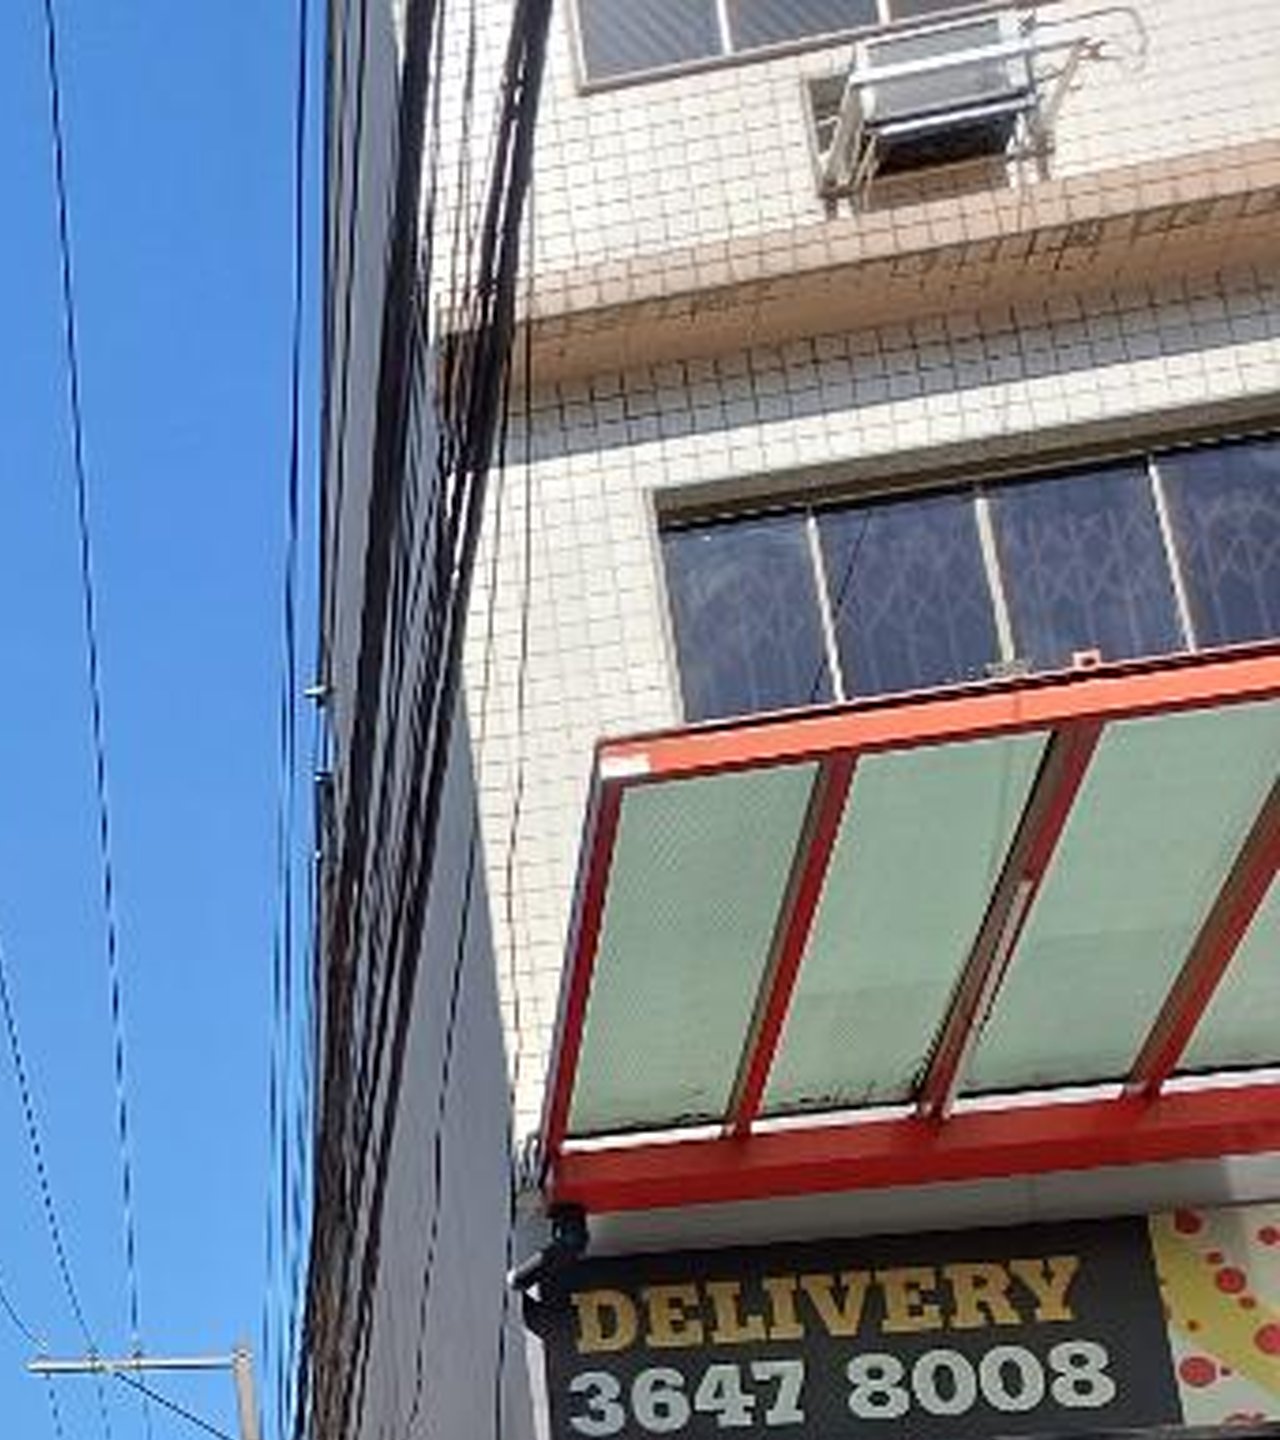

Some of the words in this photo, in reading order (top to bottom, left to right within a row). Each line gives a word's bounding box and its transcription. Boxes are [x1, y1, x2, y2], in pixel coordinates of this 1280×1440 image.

[570, 1255, 1083, 1354] DELIVERY
[568, 1359, 806, 1438] 3647
[846, 1341, 1118, 1421] 8008
